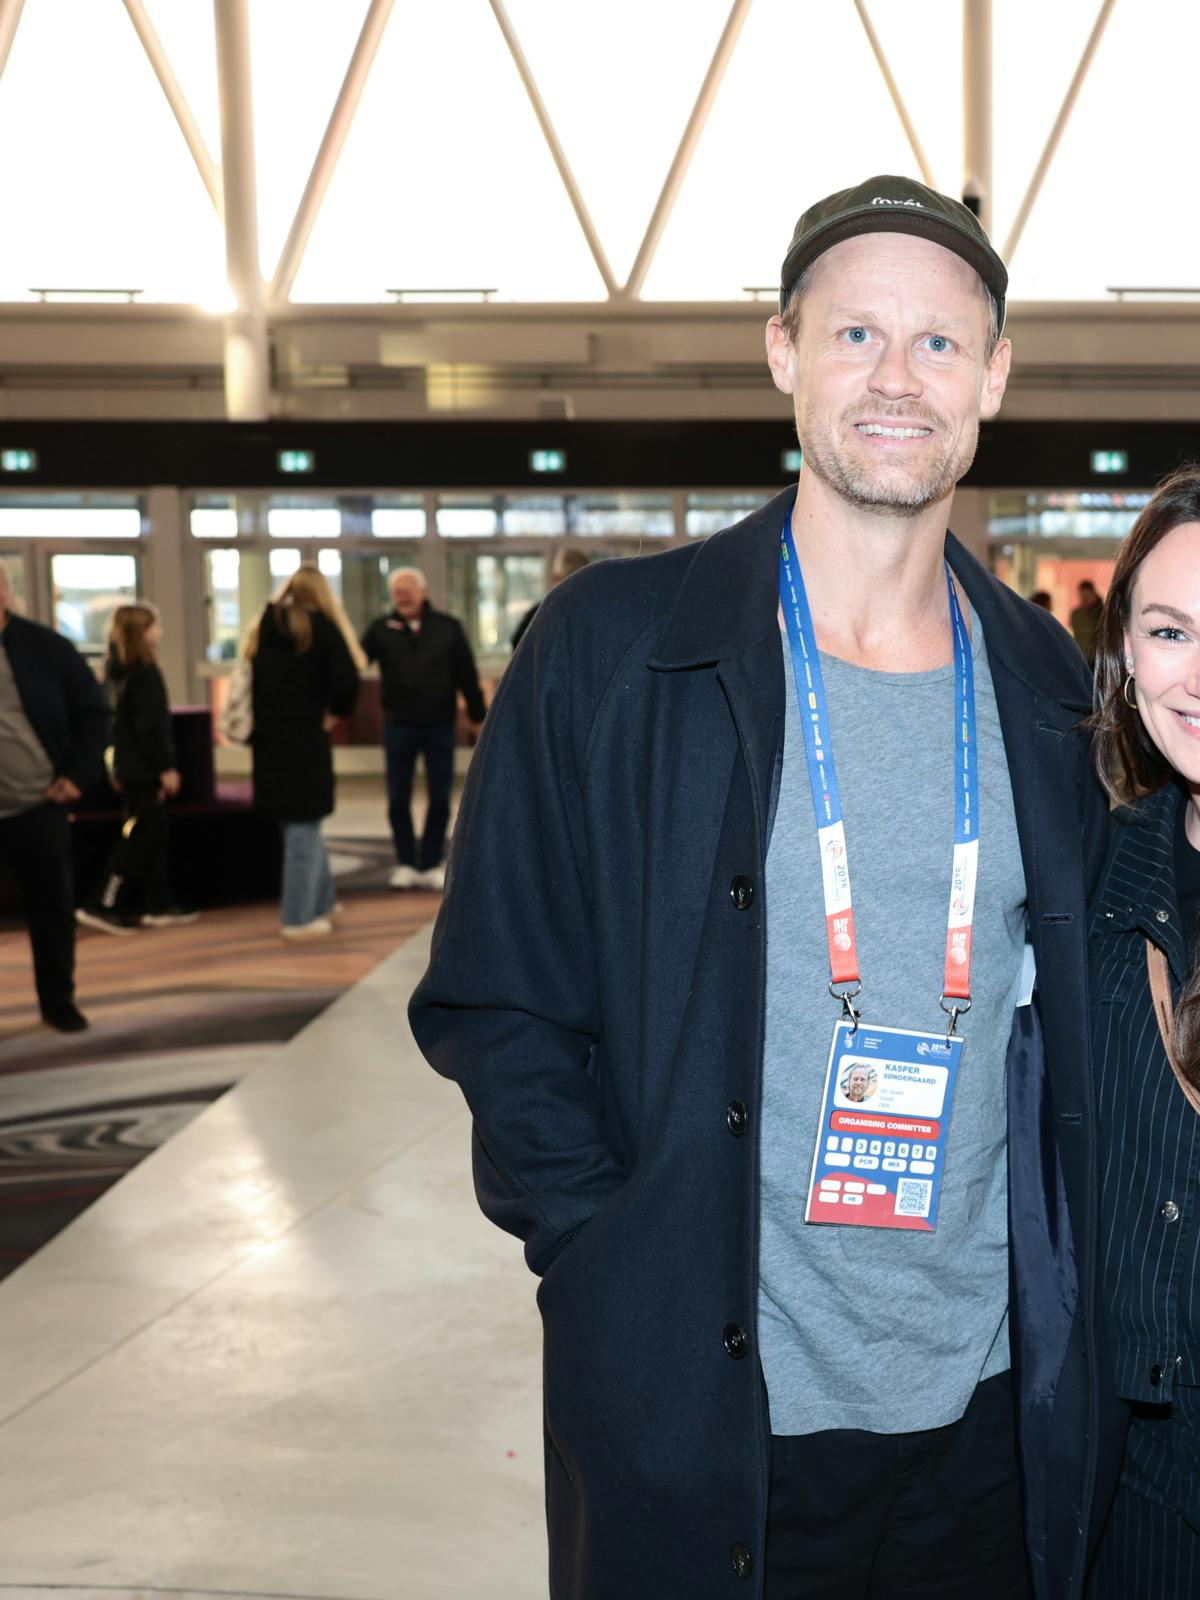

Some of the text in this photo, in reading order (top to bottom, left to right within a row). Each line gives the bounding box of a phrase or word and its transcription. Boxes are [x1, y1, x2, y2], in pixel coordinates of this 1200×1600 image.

[884, 1063, 920, 1074] KASPER
[838, 1117, 932, 1133] ORGANISING COMMITTEE
